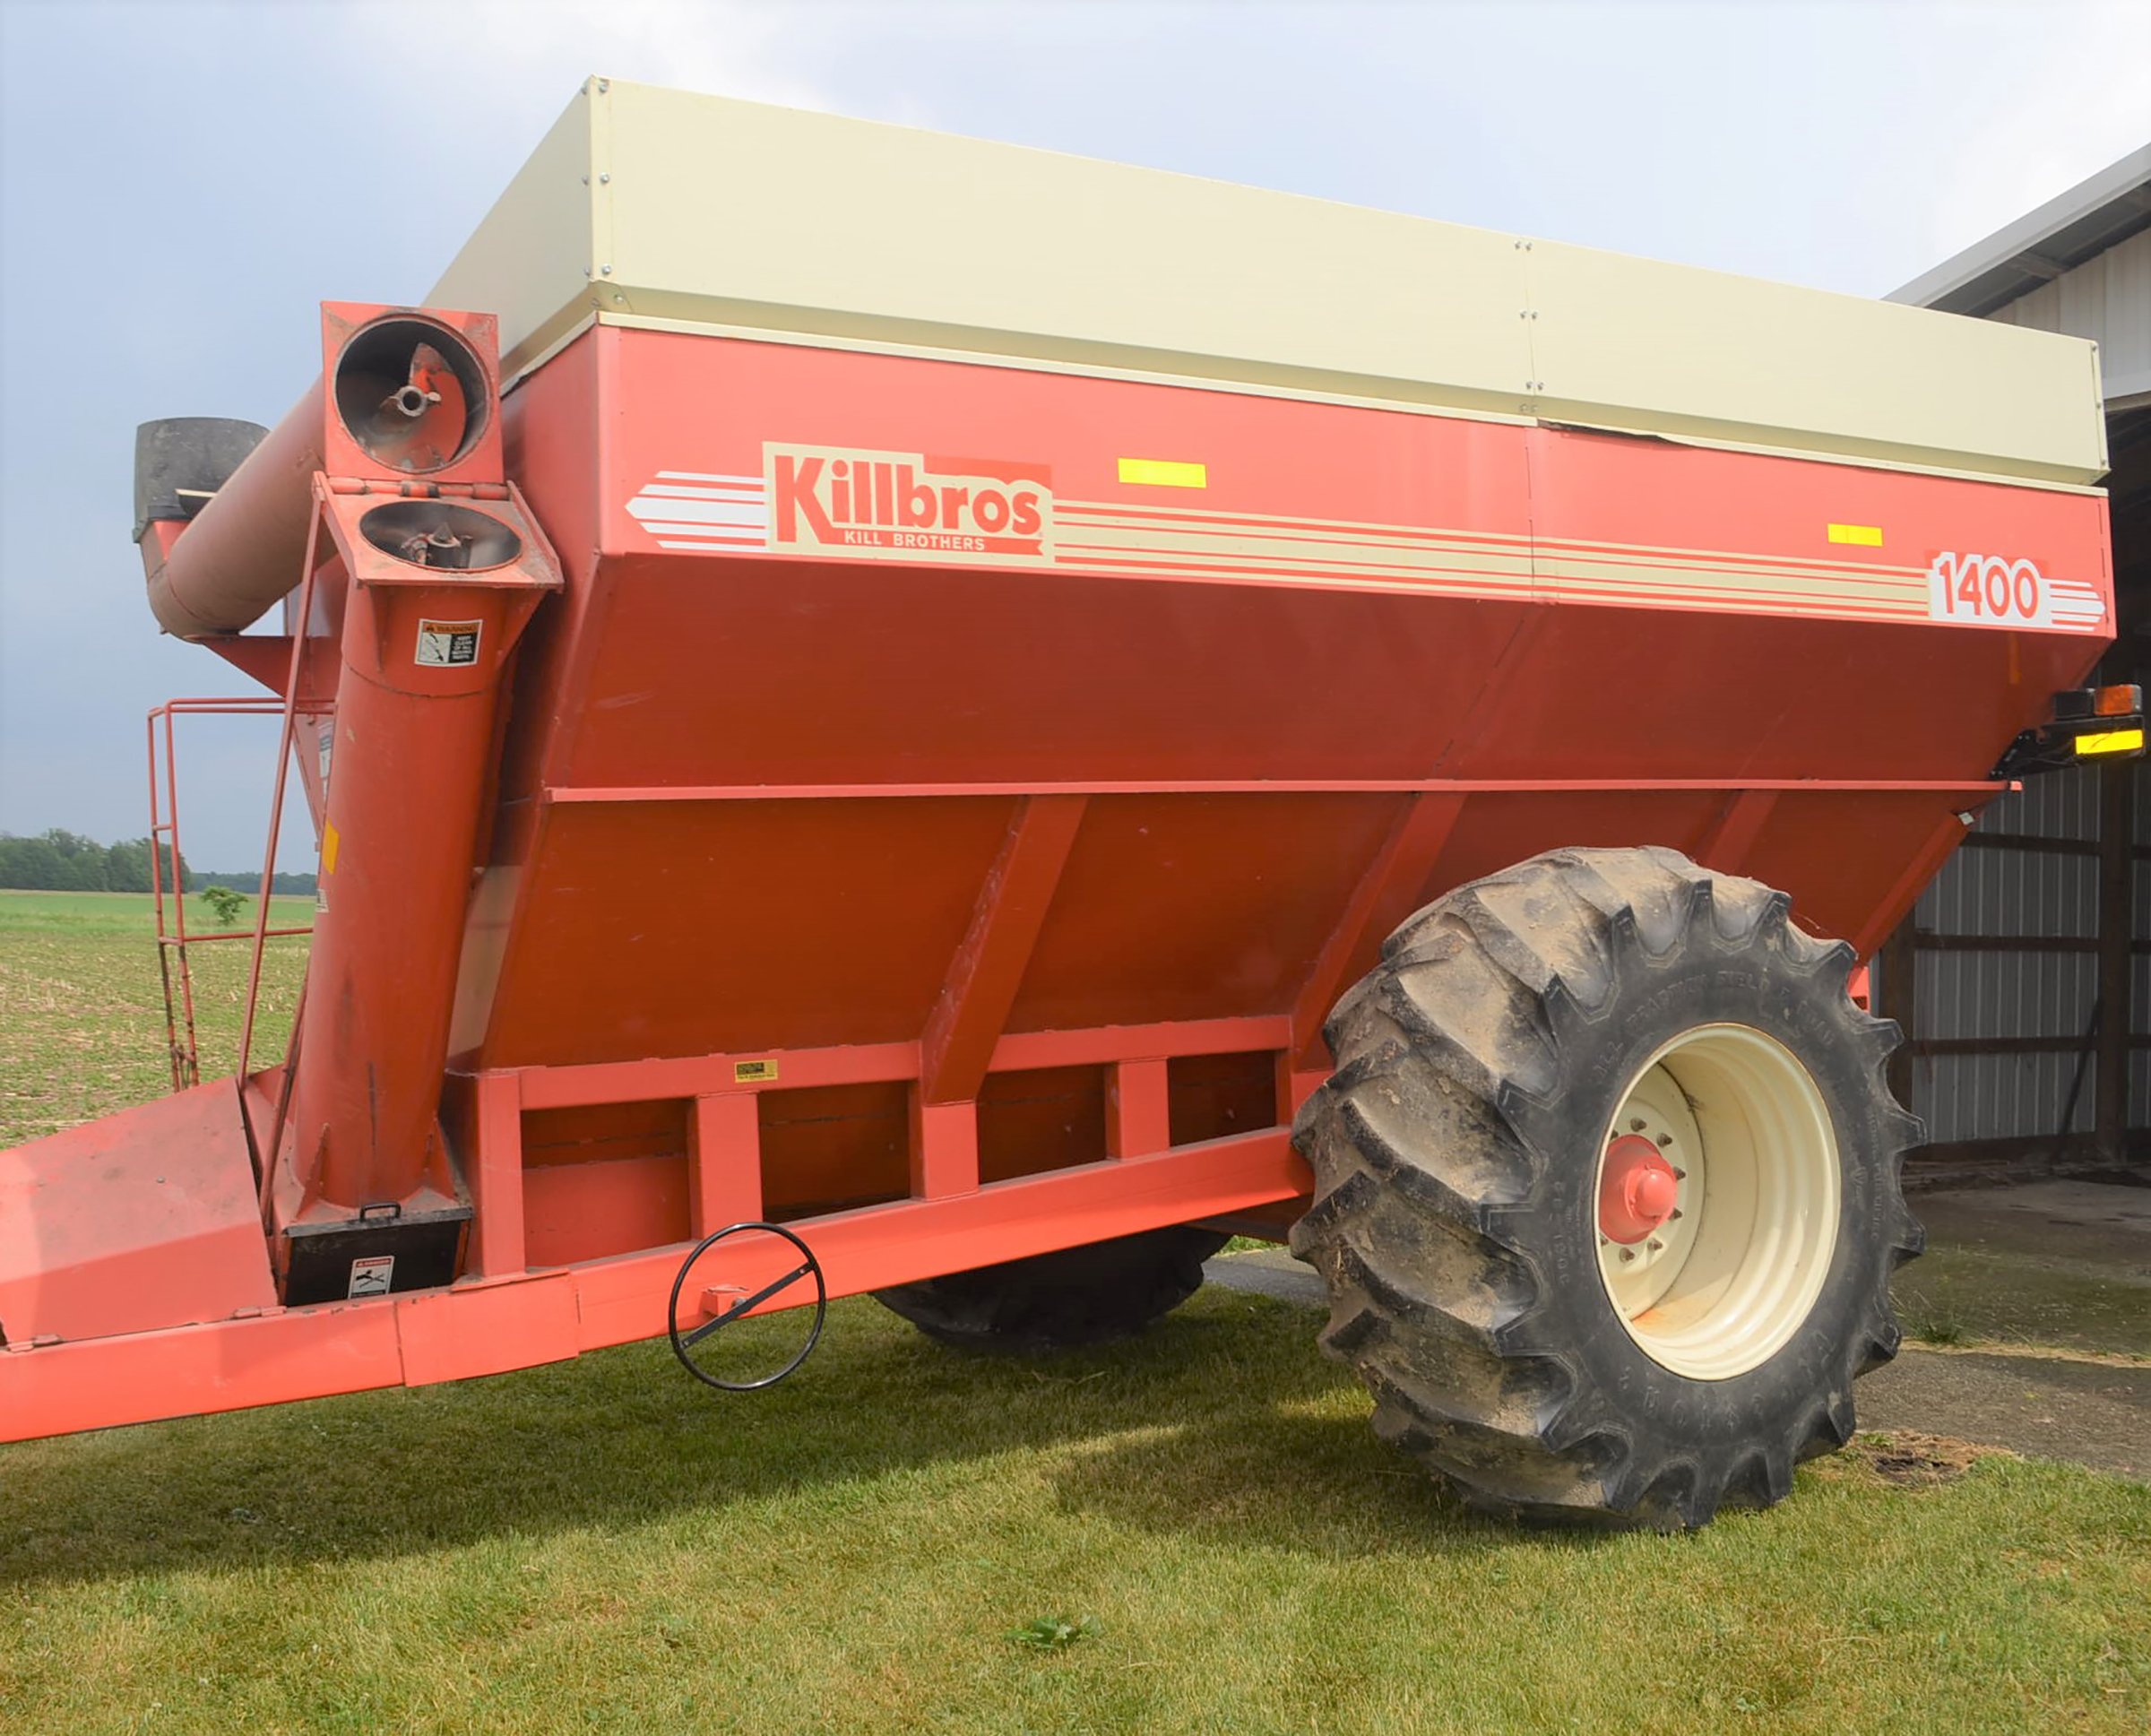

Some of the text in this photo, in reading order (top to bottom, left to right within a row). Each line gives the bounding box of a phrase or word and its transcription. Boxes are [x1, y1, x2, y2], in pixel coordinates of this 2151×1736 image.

[774, 454, 1041, 543] Killbros
[844, 530, 985, 551] KILL BROTHERS
[1939, 559, 2039, 619] 1400
